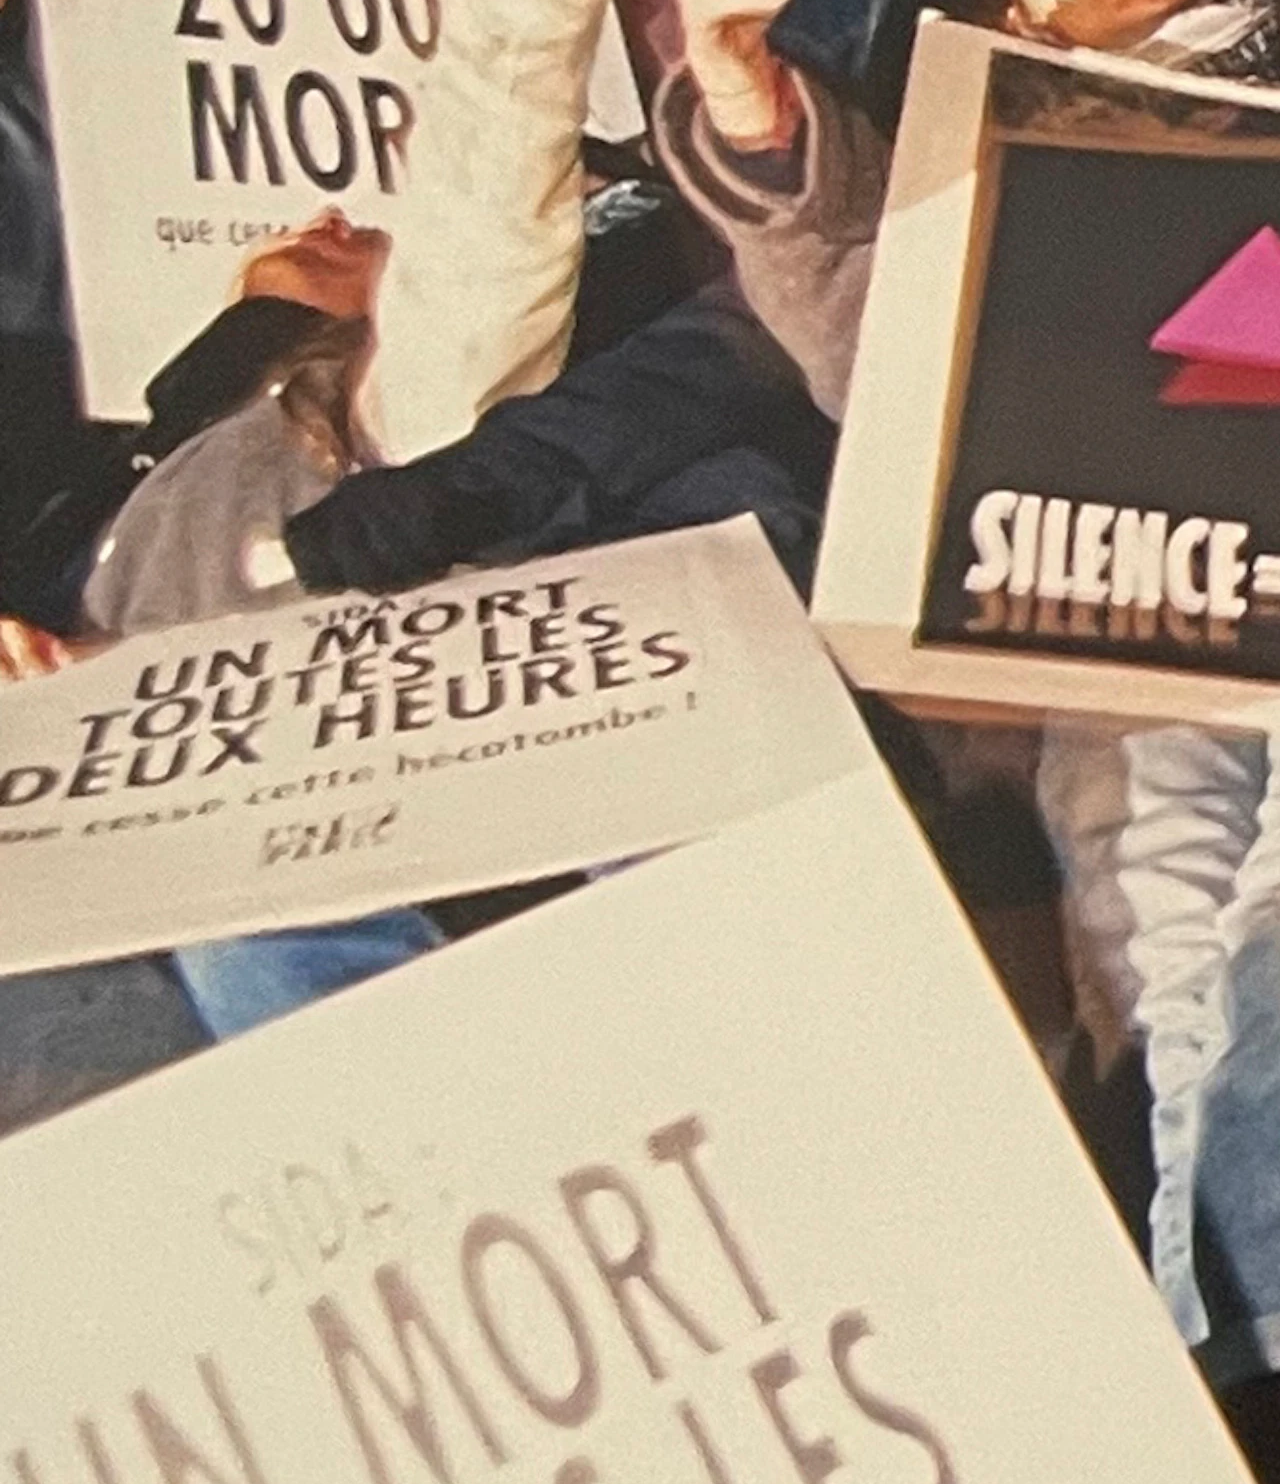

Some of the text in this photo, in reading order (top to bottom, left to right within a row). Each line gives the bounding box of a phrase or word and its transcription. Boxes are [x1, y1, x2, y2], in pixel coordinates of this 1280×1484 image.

[186, 60, 417, 194] MOR
[79, 602, 627, 757] TOUTES LES
[134, 575, 583, 702] UN MORT
[0, 629, 694, 808] DEUX HEURES
